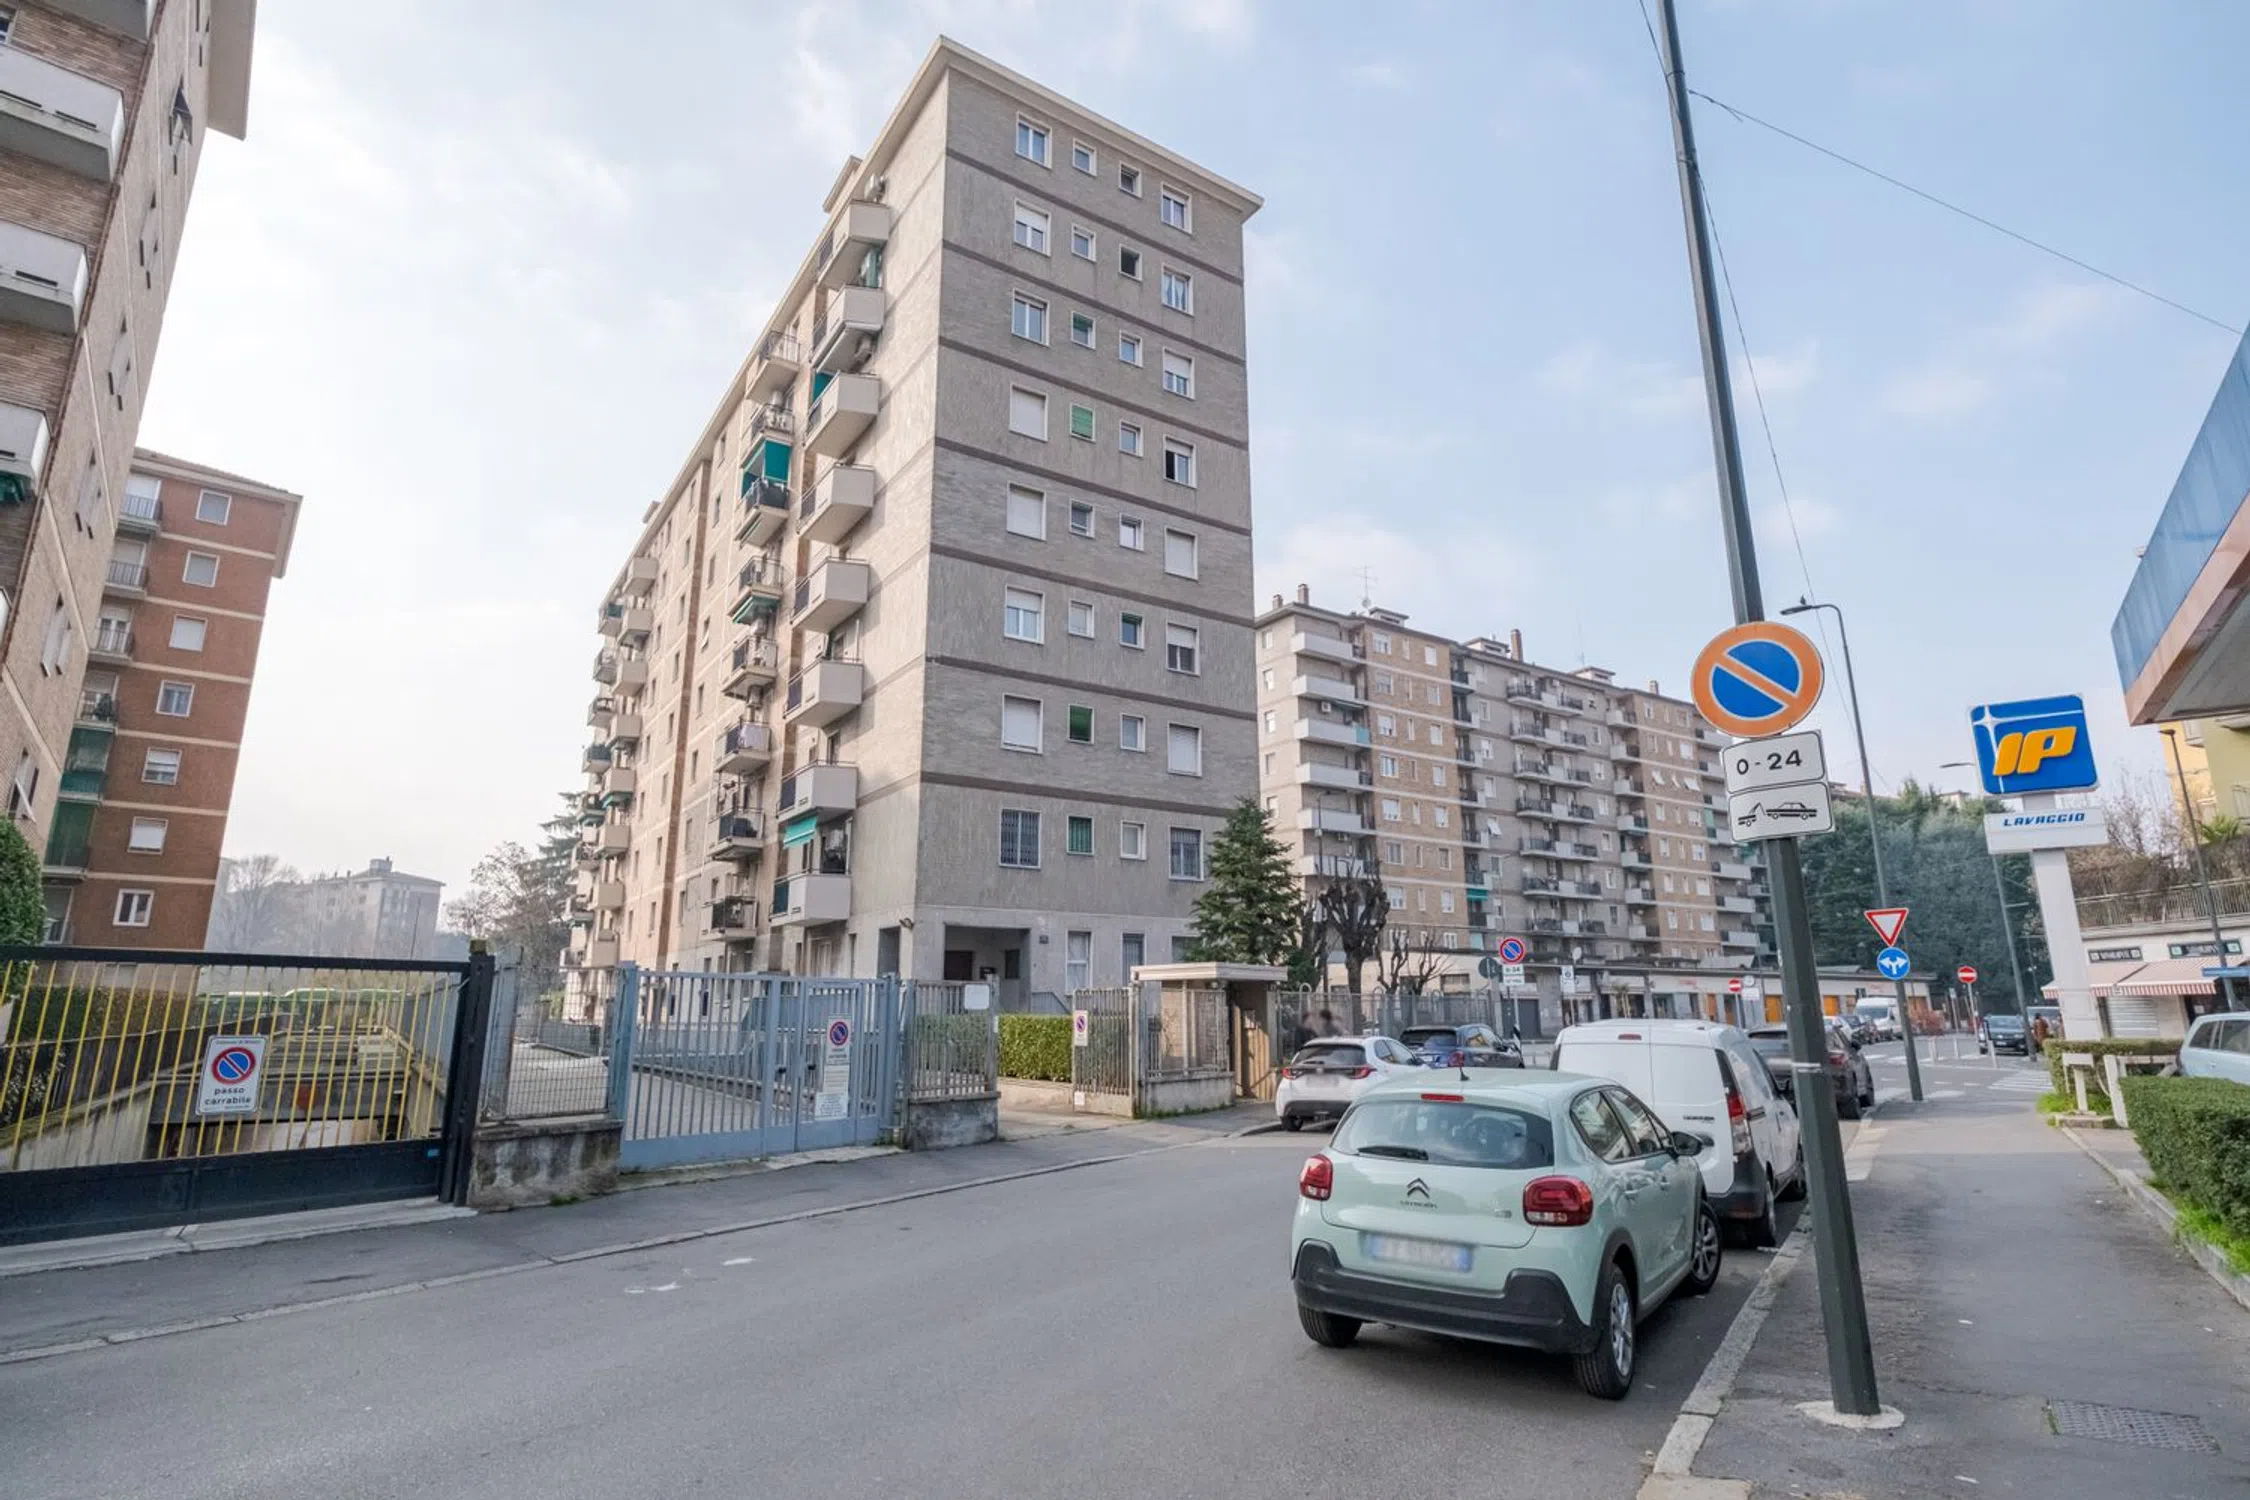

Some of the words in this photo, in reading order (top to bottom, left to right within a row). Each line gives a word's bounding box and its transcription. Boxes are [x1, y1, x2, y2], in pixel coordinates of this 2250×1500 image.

[1993, 726, 2077, 776] IP
[2003, 812, 2086, 827] LAVAGGIO
[214, 1087, 245, 1096] passo
[204, 1096, 251, 1105] carrabile
